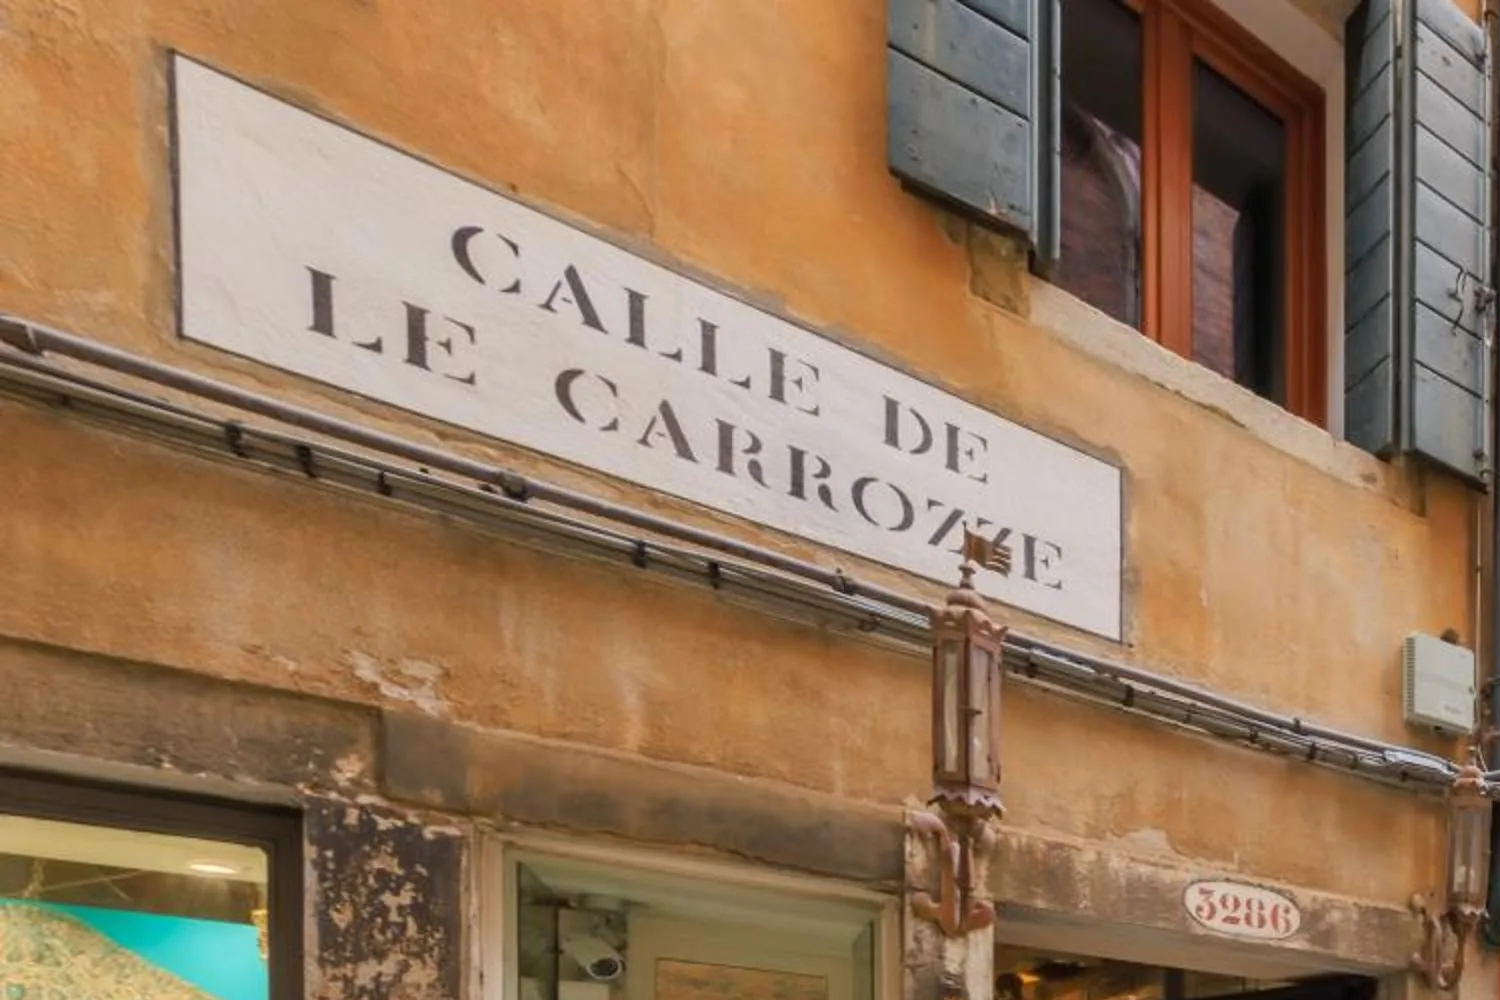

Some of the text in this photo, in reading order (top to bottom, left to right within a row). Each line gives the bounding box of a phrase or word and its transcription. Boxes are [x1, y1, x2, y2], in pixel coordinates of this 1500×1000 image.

[305, 265, 476, 386] LE
[451, 226, 988, 485] CALLE DE
[1195, 886, 1292, 935] 3286
